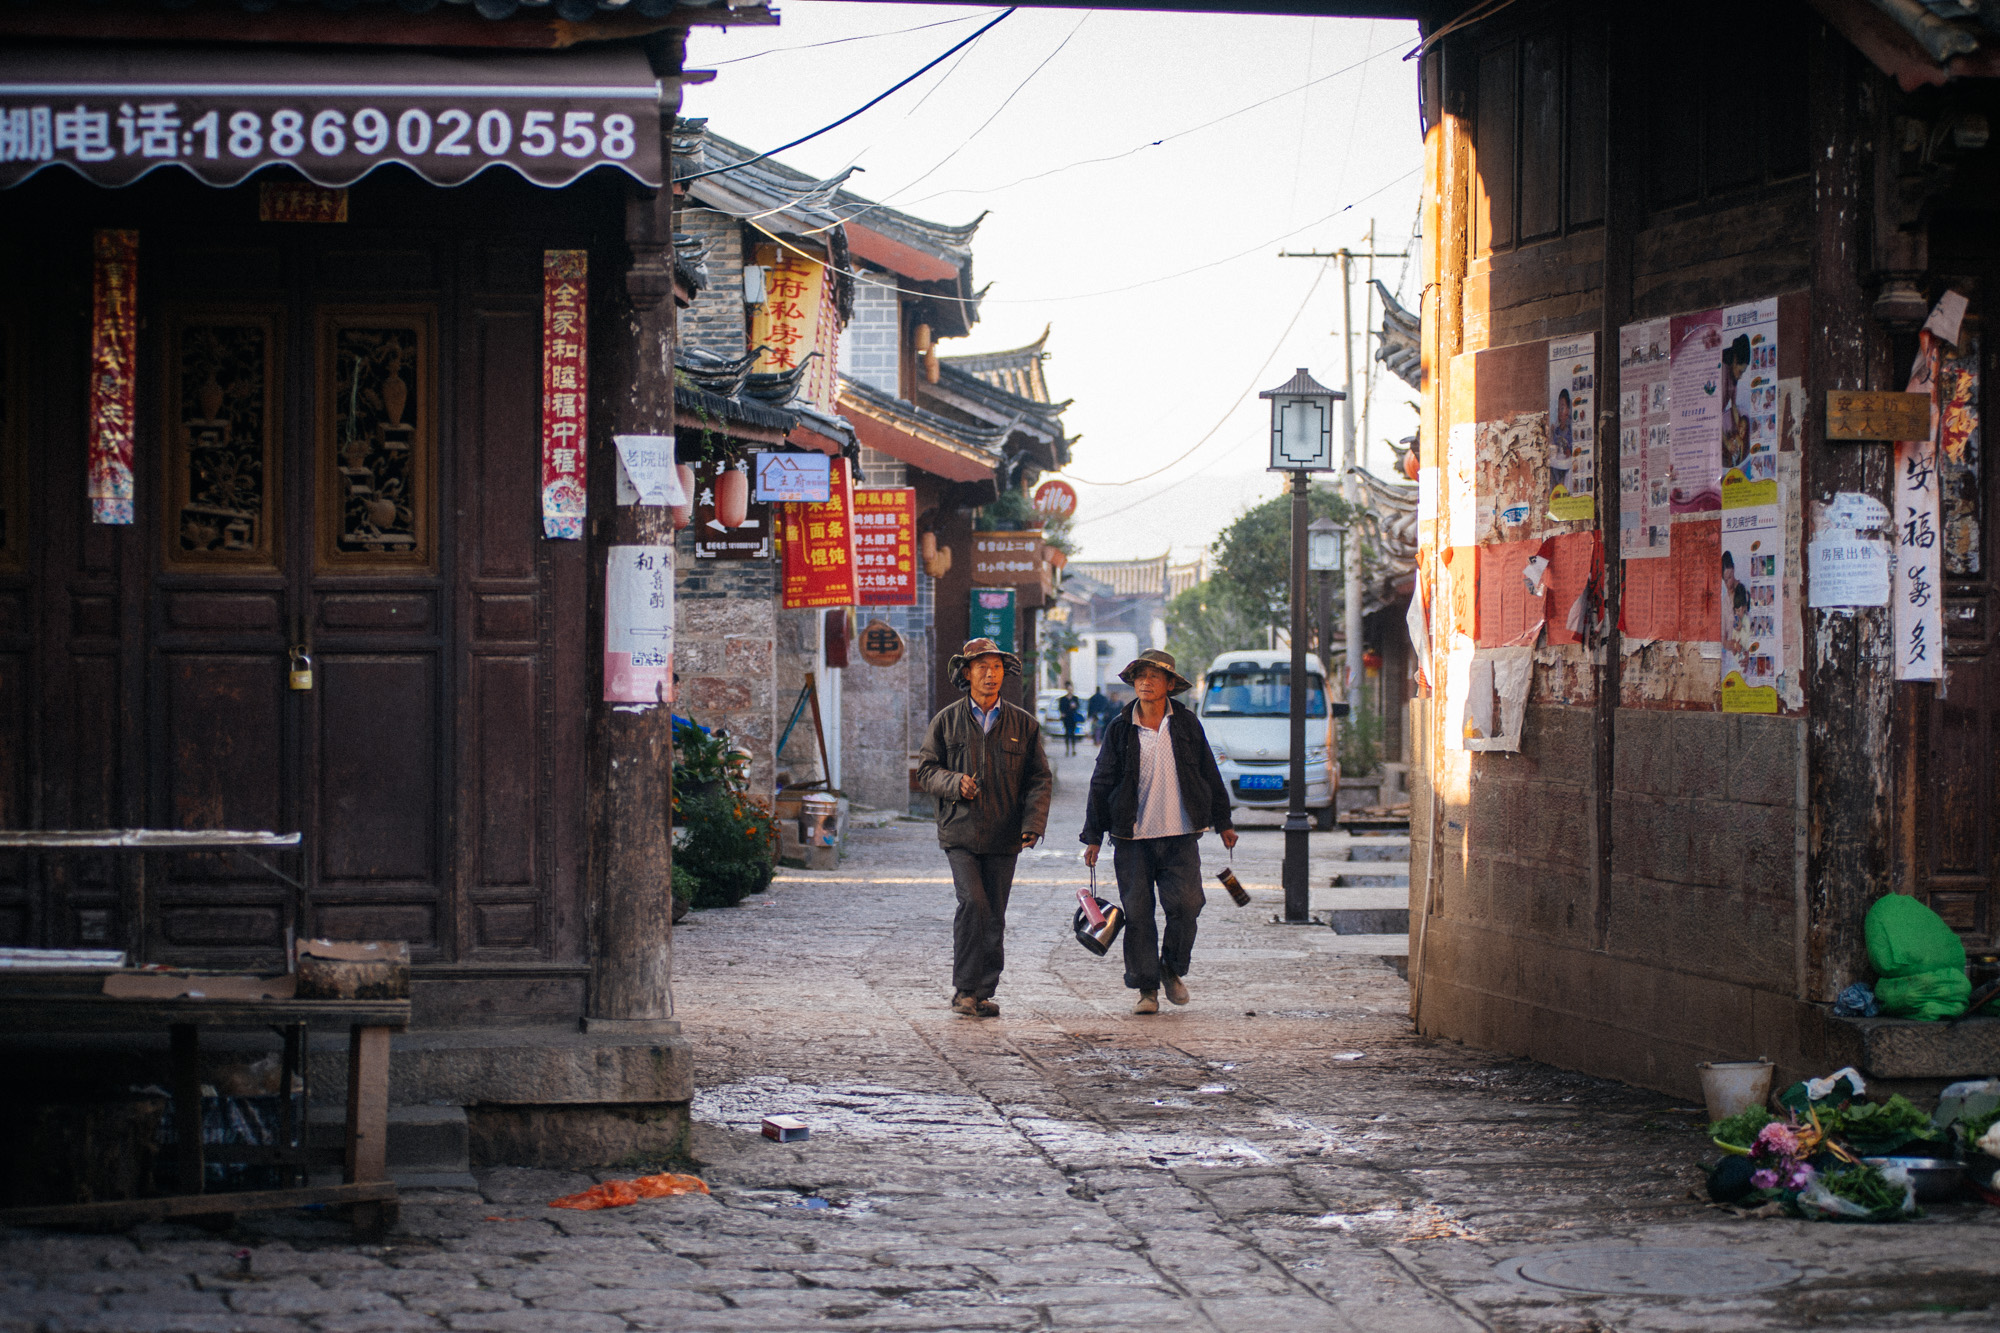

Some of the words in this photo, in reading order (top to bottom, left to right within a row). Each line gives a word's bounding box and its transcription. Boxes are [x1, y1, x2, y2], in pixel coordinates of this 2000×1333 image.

[763, 256, 810, 369] 王府私房菜
[551, 283, 579, 473] 全家和睦福中福
[1036, 487, 1073, 513] illy
[808, 521, 844, 539] 面条
[811, 547, 846, 565] 馄饨
[1821, 546, 1872, 561] 房屋出售
